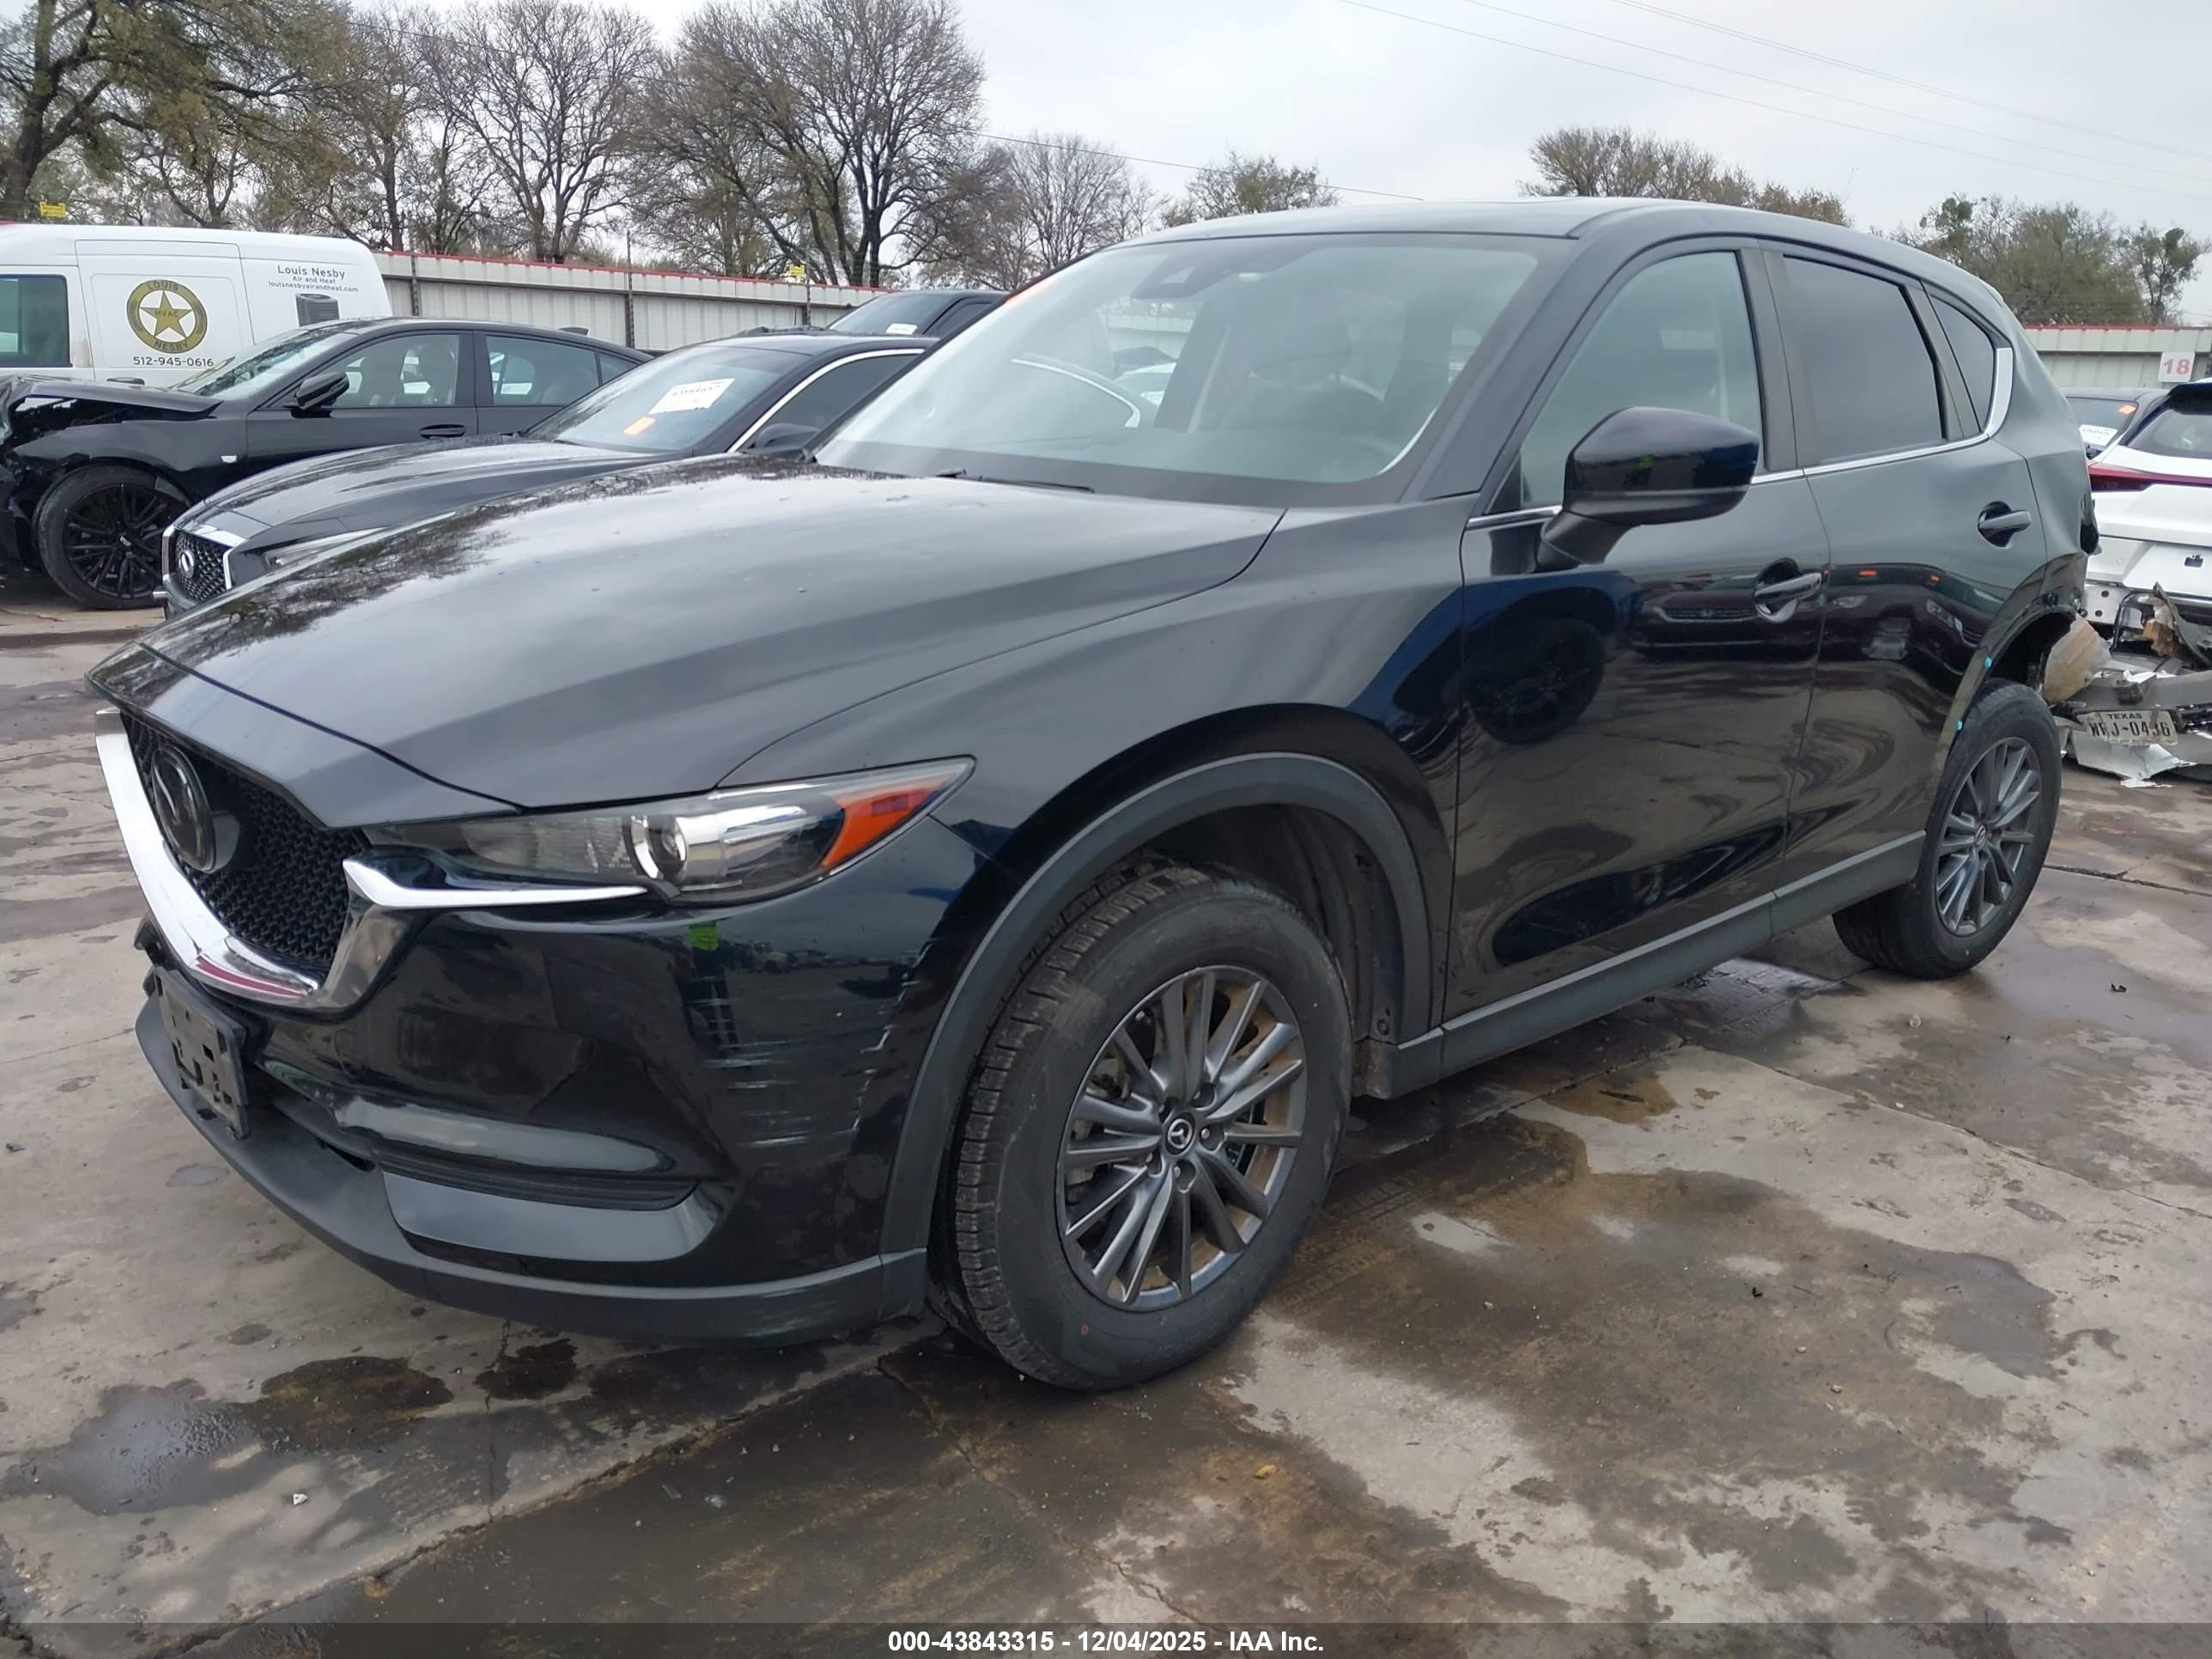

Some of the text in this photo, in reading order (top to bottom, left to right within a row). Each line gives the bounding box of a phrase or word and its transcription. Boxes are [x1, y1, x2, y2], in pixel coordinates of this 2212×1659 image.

[277, 264, 345, 280] Louis Nesby
[147, 281, 179, 291] LOUIS
[154, 341, 189, 352] NESBY
[133, 356, 214, 368] 512-945-0616
[2163, 358, 2191, 375] 18
